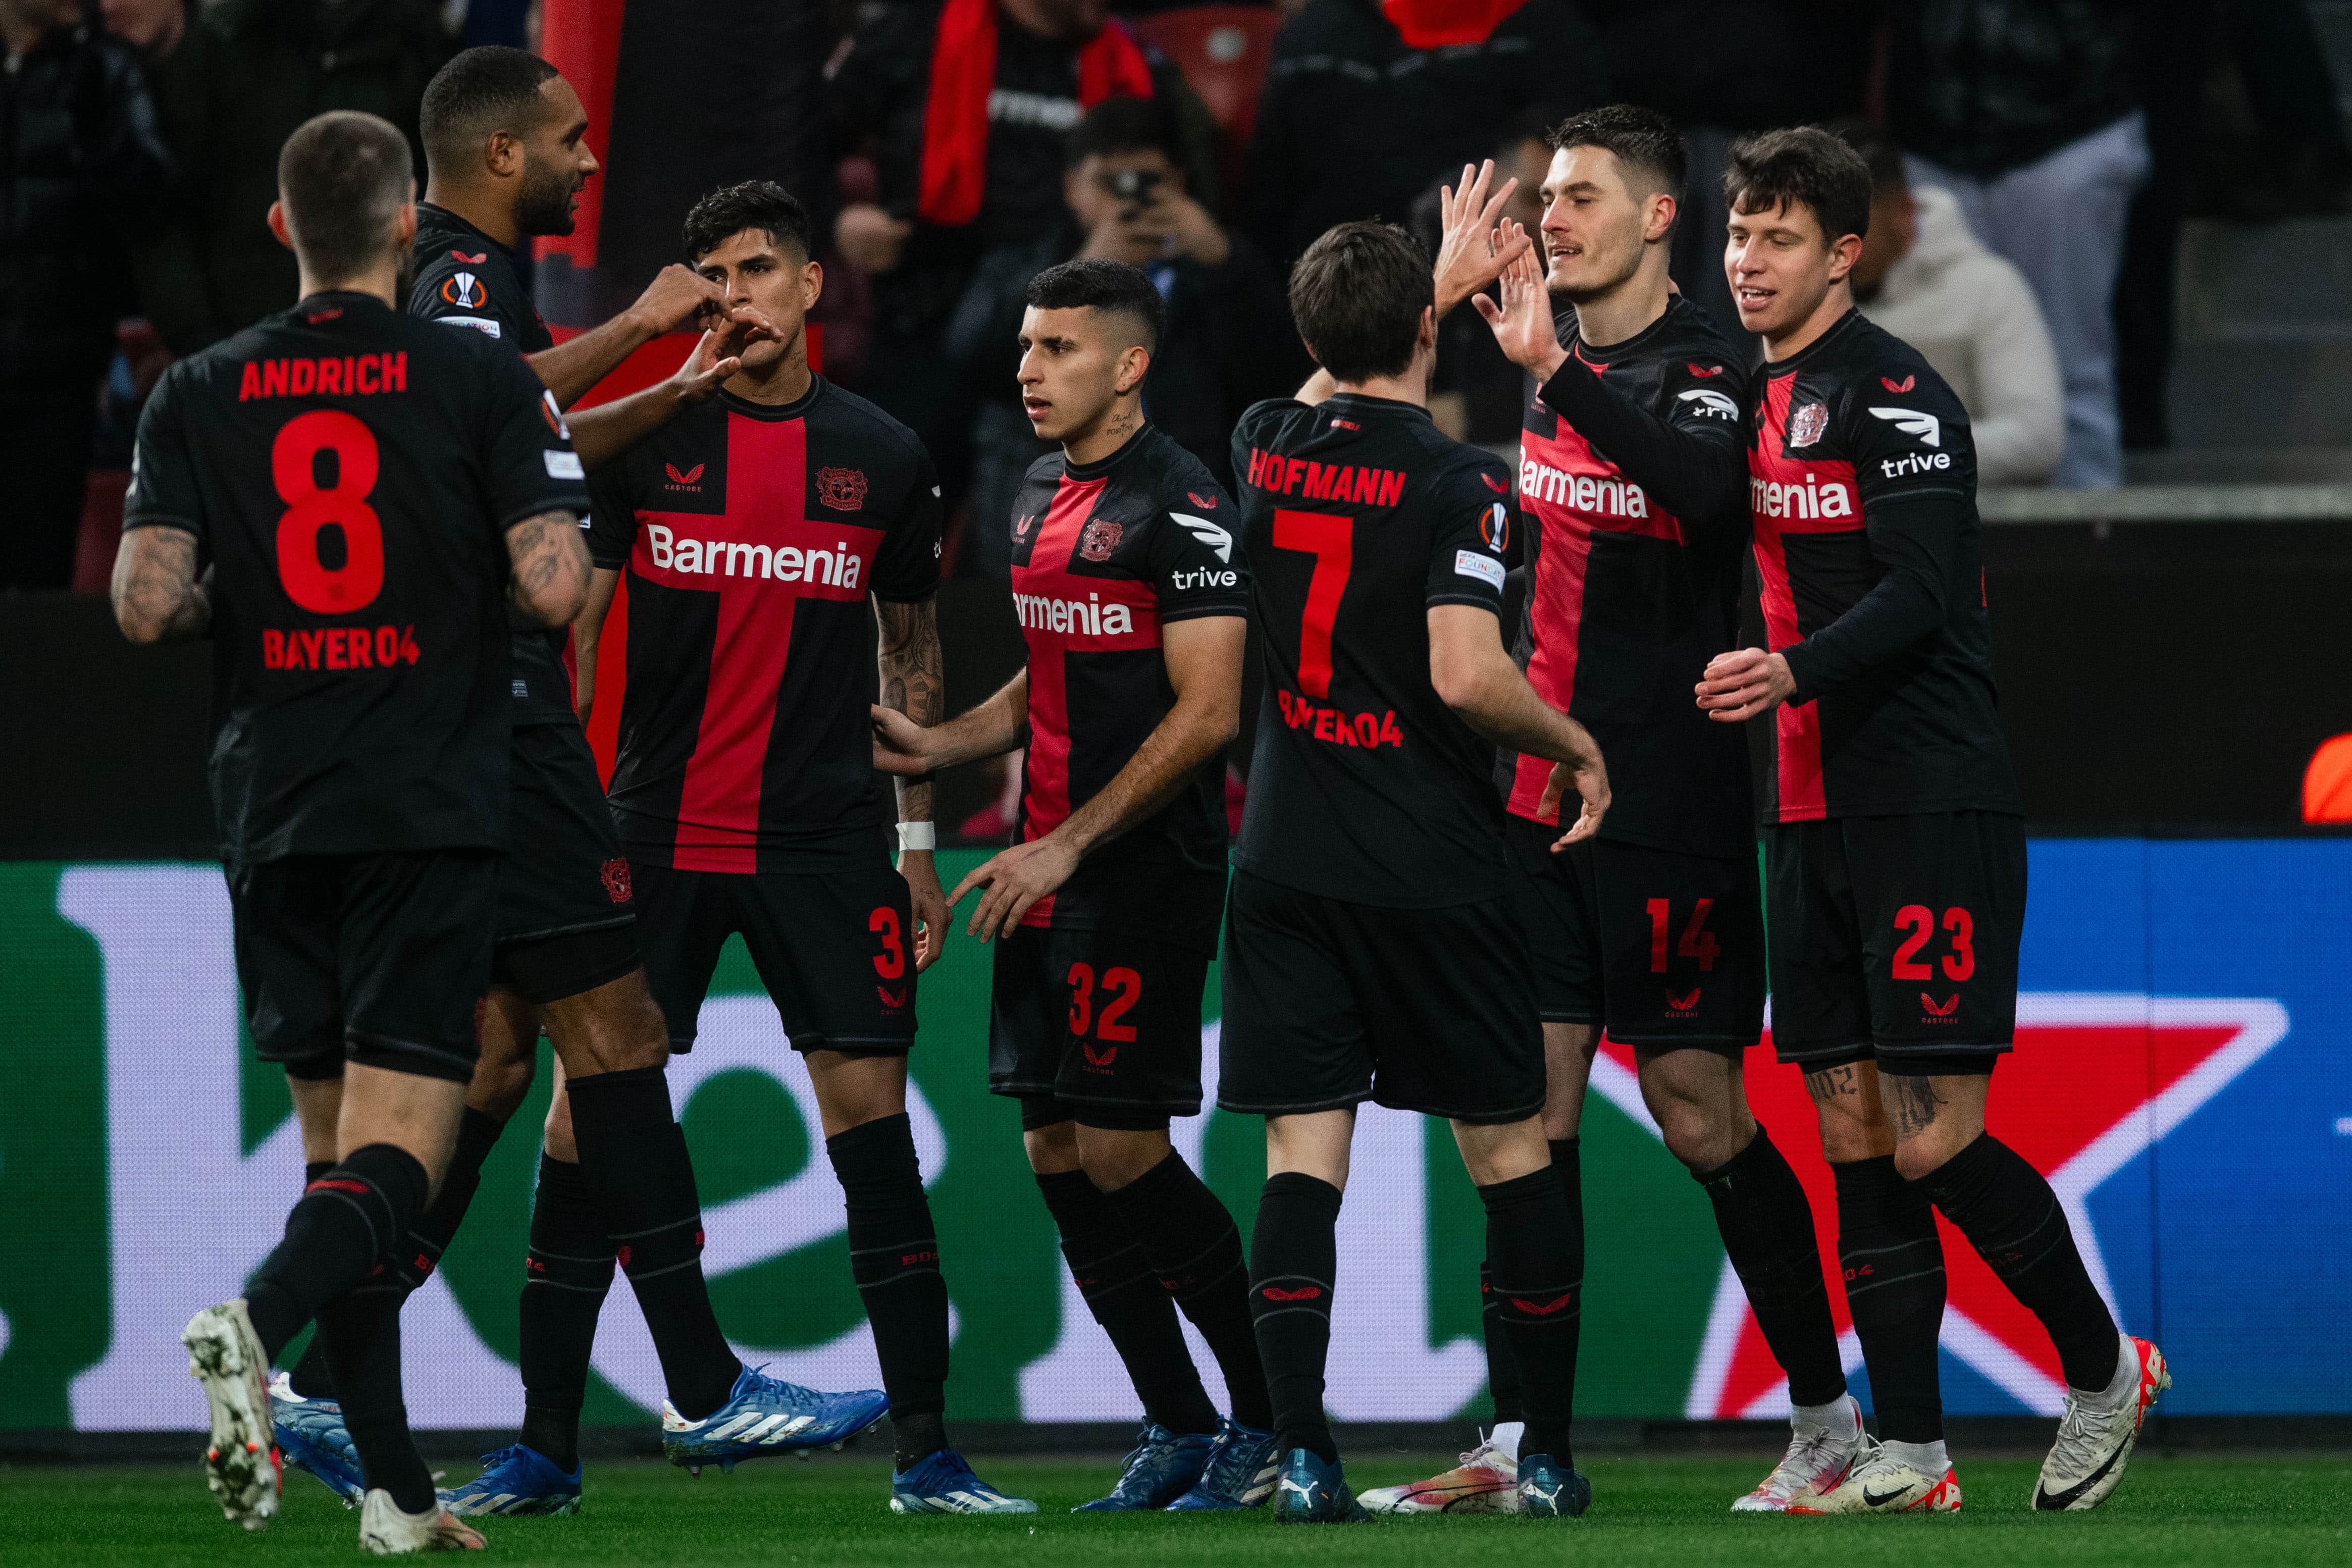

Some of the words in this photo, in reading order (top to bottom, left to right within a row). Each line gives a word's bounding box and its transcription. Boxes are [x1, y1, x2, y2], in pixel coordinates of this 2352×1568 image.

[239, 352, 407, 402] ANDRICH
[1247, 447, 1406, 507] HOFMANN
[1750, 474, 1852, 519] menia
[1881, 453, 1951, 479] trive
[272, 409, 384, 615] 8
[647, 524, 862, 589] Barmenia
[1172, 566, 1237, 590] trive
[1013, 592, 1134, 636] armenia
[1272, 508, 1354, 700] 7
[869, 906, 905, 979] 3
[1646, 898, 1720, 973] 14
[1891, 904, 1975, 982] 23
[1067, 962, 1141, 1042] 32
